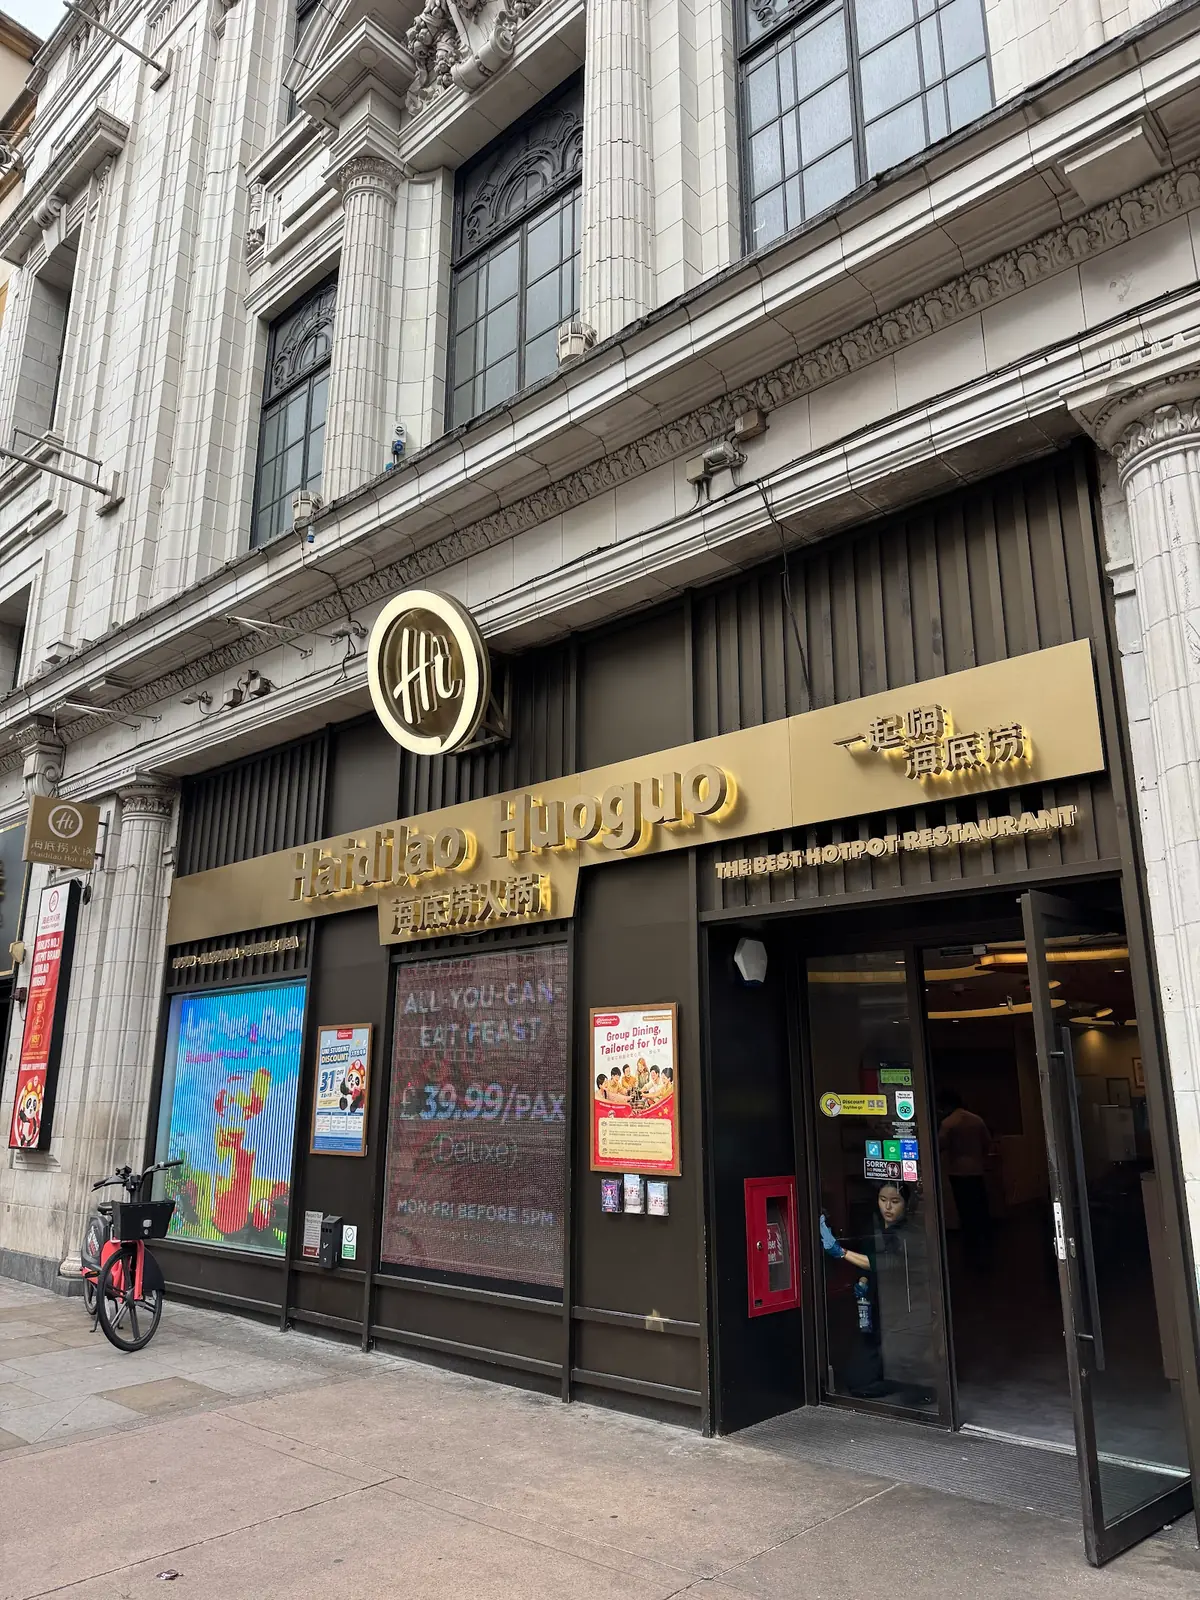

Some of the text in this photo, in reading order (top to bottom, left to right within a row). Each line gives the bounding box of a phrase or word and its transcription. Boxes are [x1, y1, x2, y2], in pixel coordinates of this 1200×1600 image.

[833, 703, 949, 752] 一起嗨
[903, 722, 1028, 780] 海底捞
[287, 763, 728, 903] Haidilao Huoguo
[715, 804, 1078, 880] THE BEST HOTPOT RESTAURANT
[390, 872, 543, 935] 海底捞火锅
[420, 1017, 542, 1048] EAT FEAST
[600, 1035, 668, 1055] Tailored for You
[606, 1024, 661, 1041] Group Dining,
[321, 1053, 349, 1064] DISCOUNT
[319, 1069, 336, 1092] 31
[866, 1160, 888, 1168] SORRY
[457, 1203, 518, 1224] BEFORE
